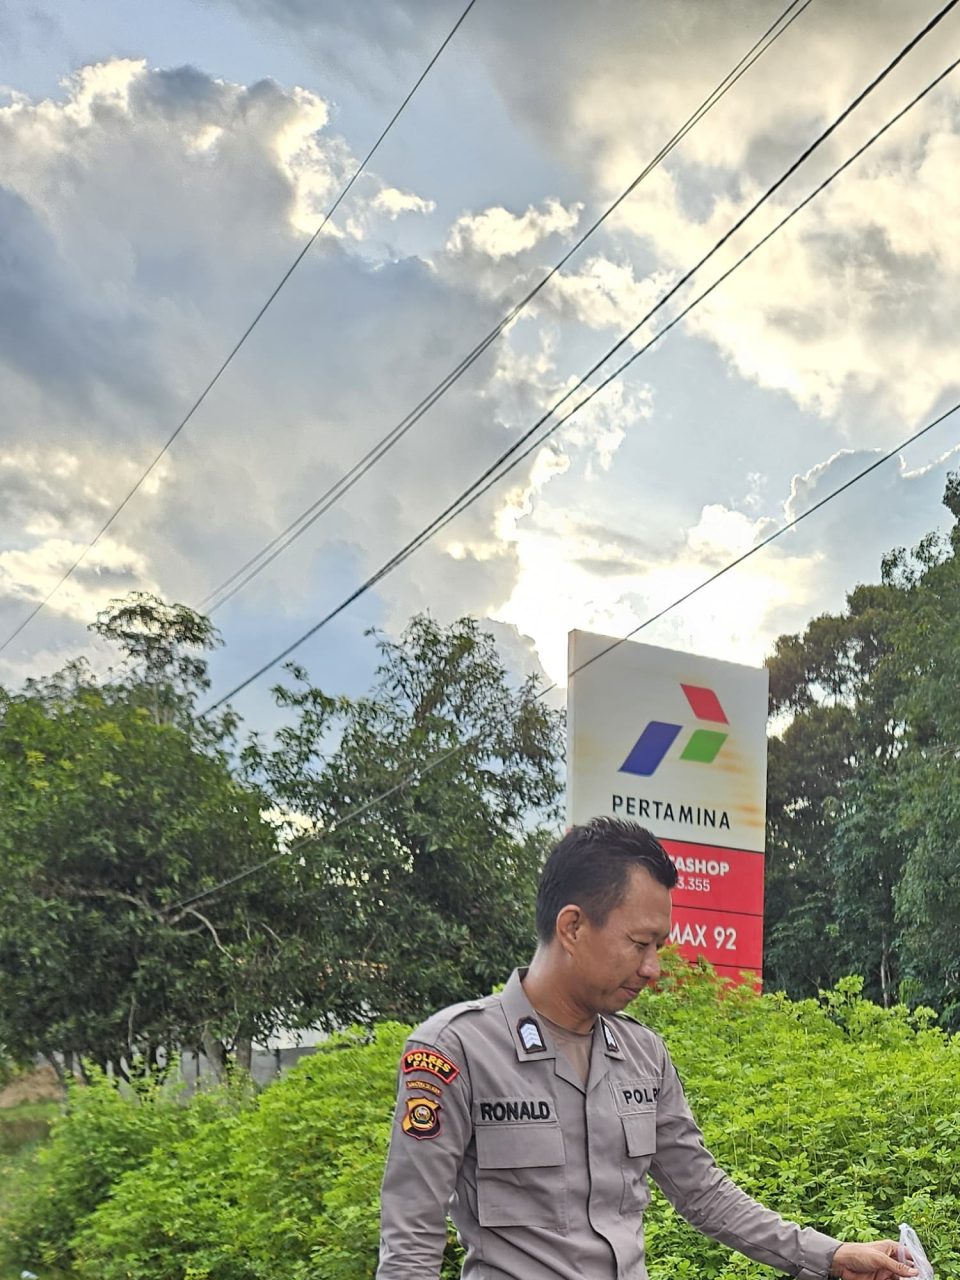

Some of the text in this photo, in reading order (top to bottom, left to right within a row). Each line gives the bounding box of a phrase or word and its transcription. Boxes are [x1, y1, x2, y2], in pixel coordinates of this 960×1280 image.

[612, 794, 730, 830] PERTAMINA
[713, 925, 737, 950] 92
[407, 1052, 451, 1073] POLRES
[413, 1060, 440, 1072] PALI
[622, 1087, 660, 1105] POLR
[480, 1101, 550, 1121] RONALD
